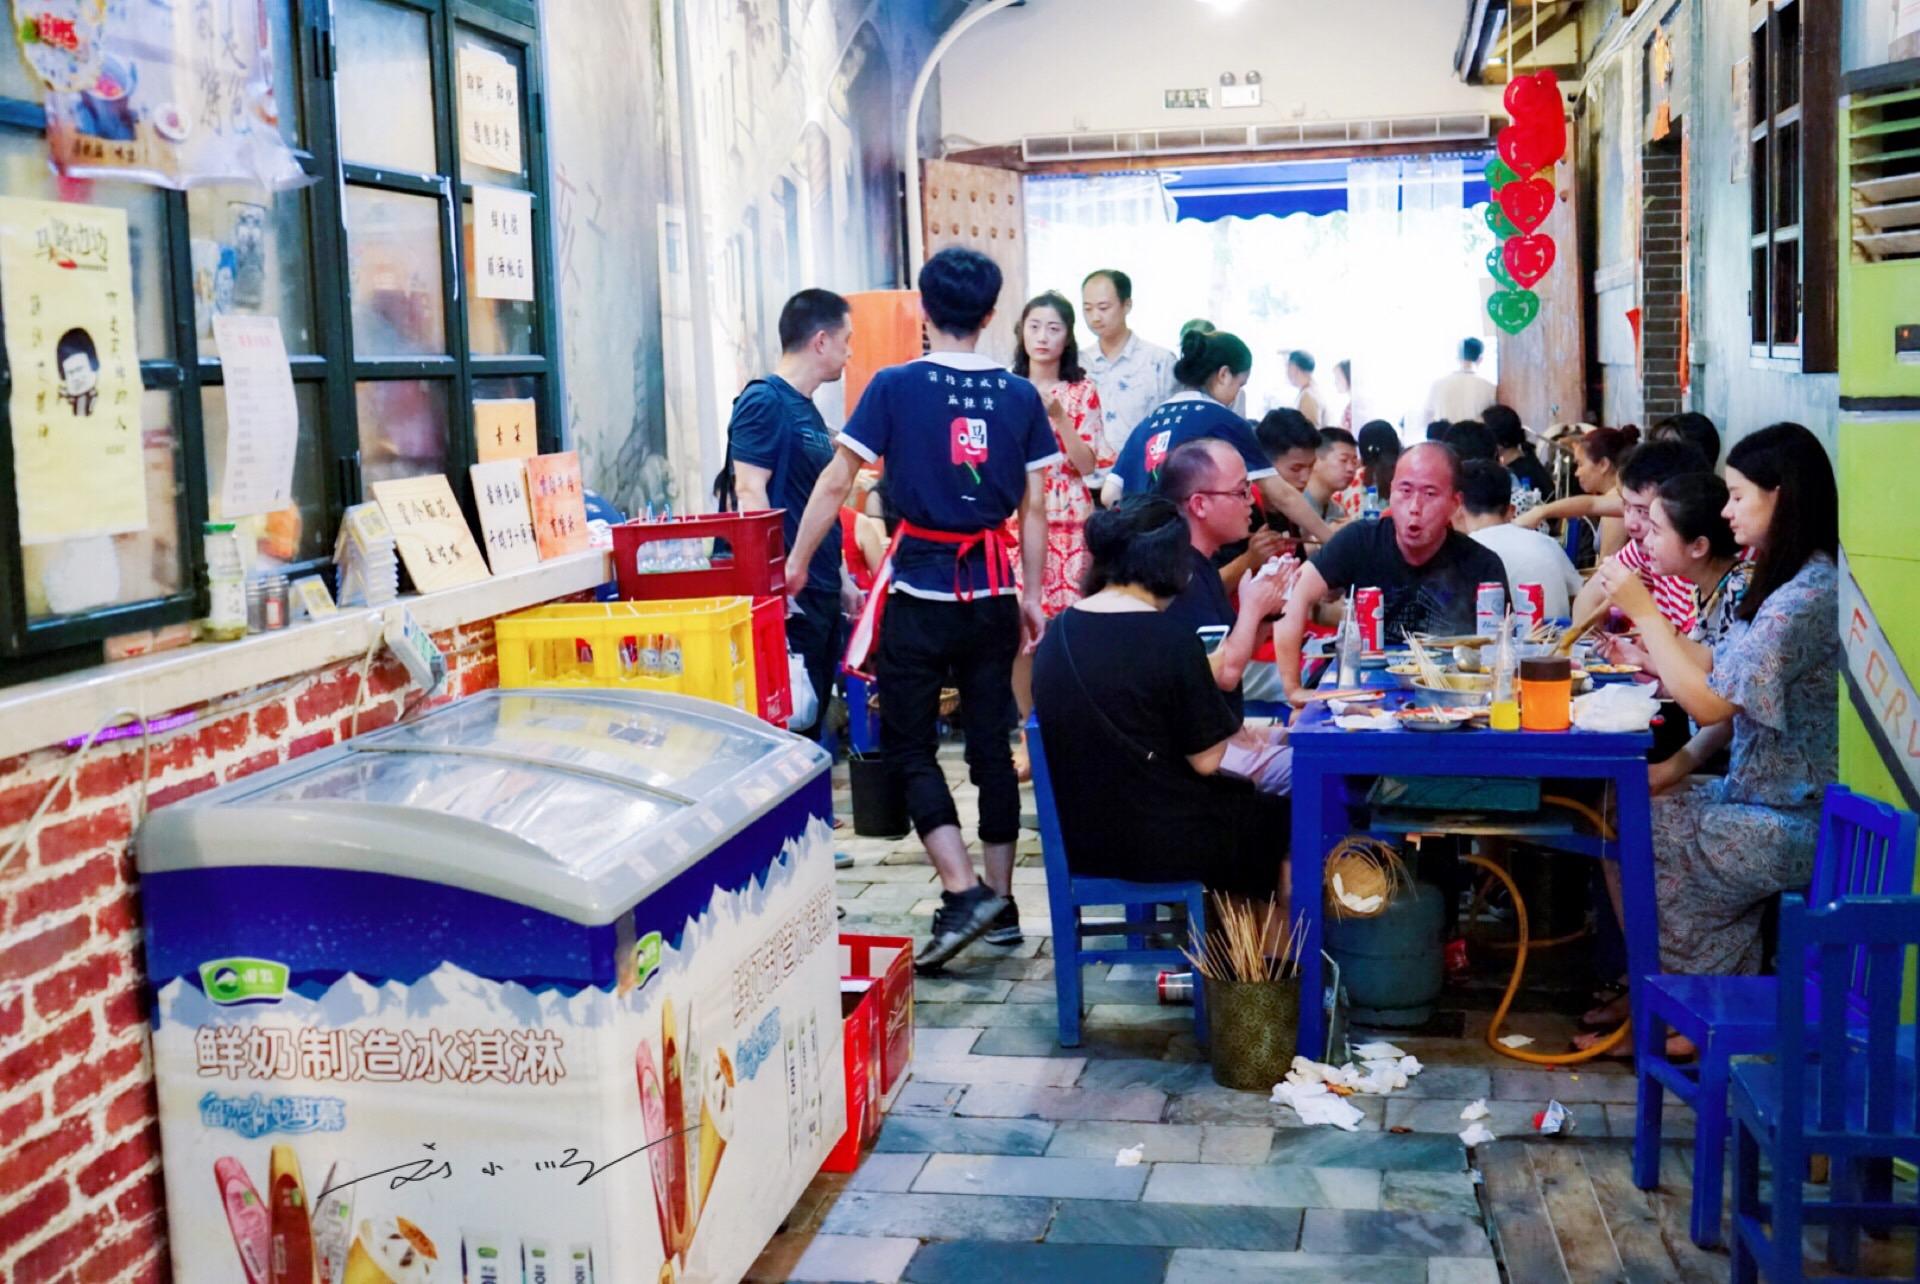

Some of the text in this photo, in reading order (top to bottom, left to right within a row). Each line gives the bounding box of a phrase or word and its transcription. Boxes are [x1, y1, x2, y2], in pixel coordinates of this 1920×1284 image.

[193, 1024, 567, 1086] 鲜奶制造冰淇淋
